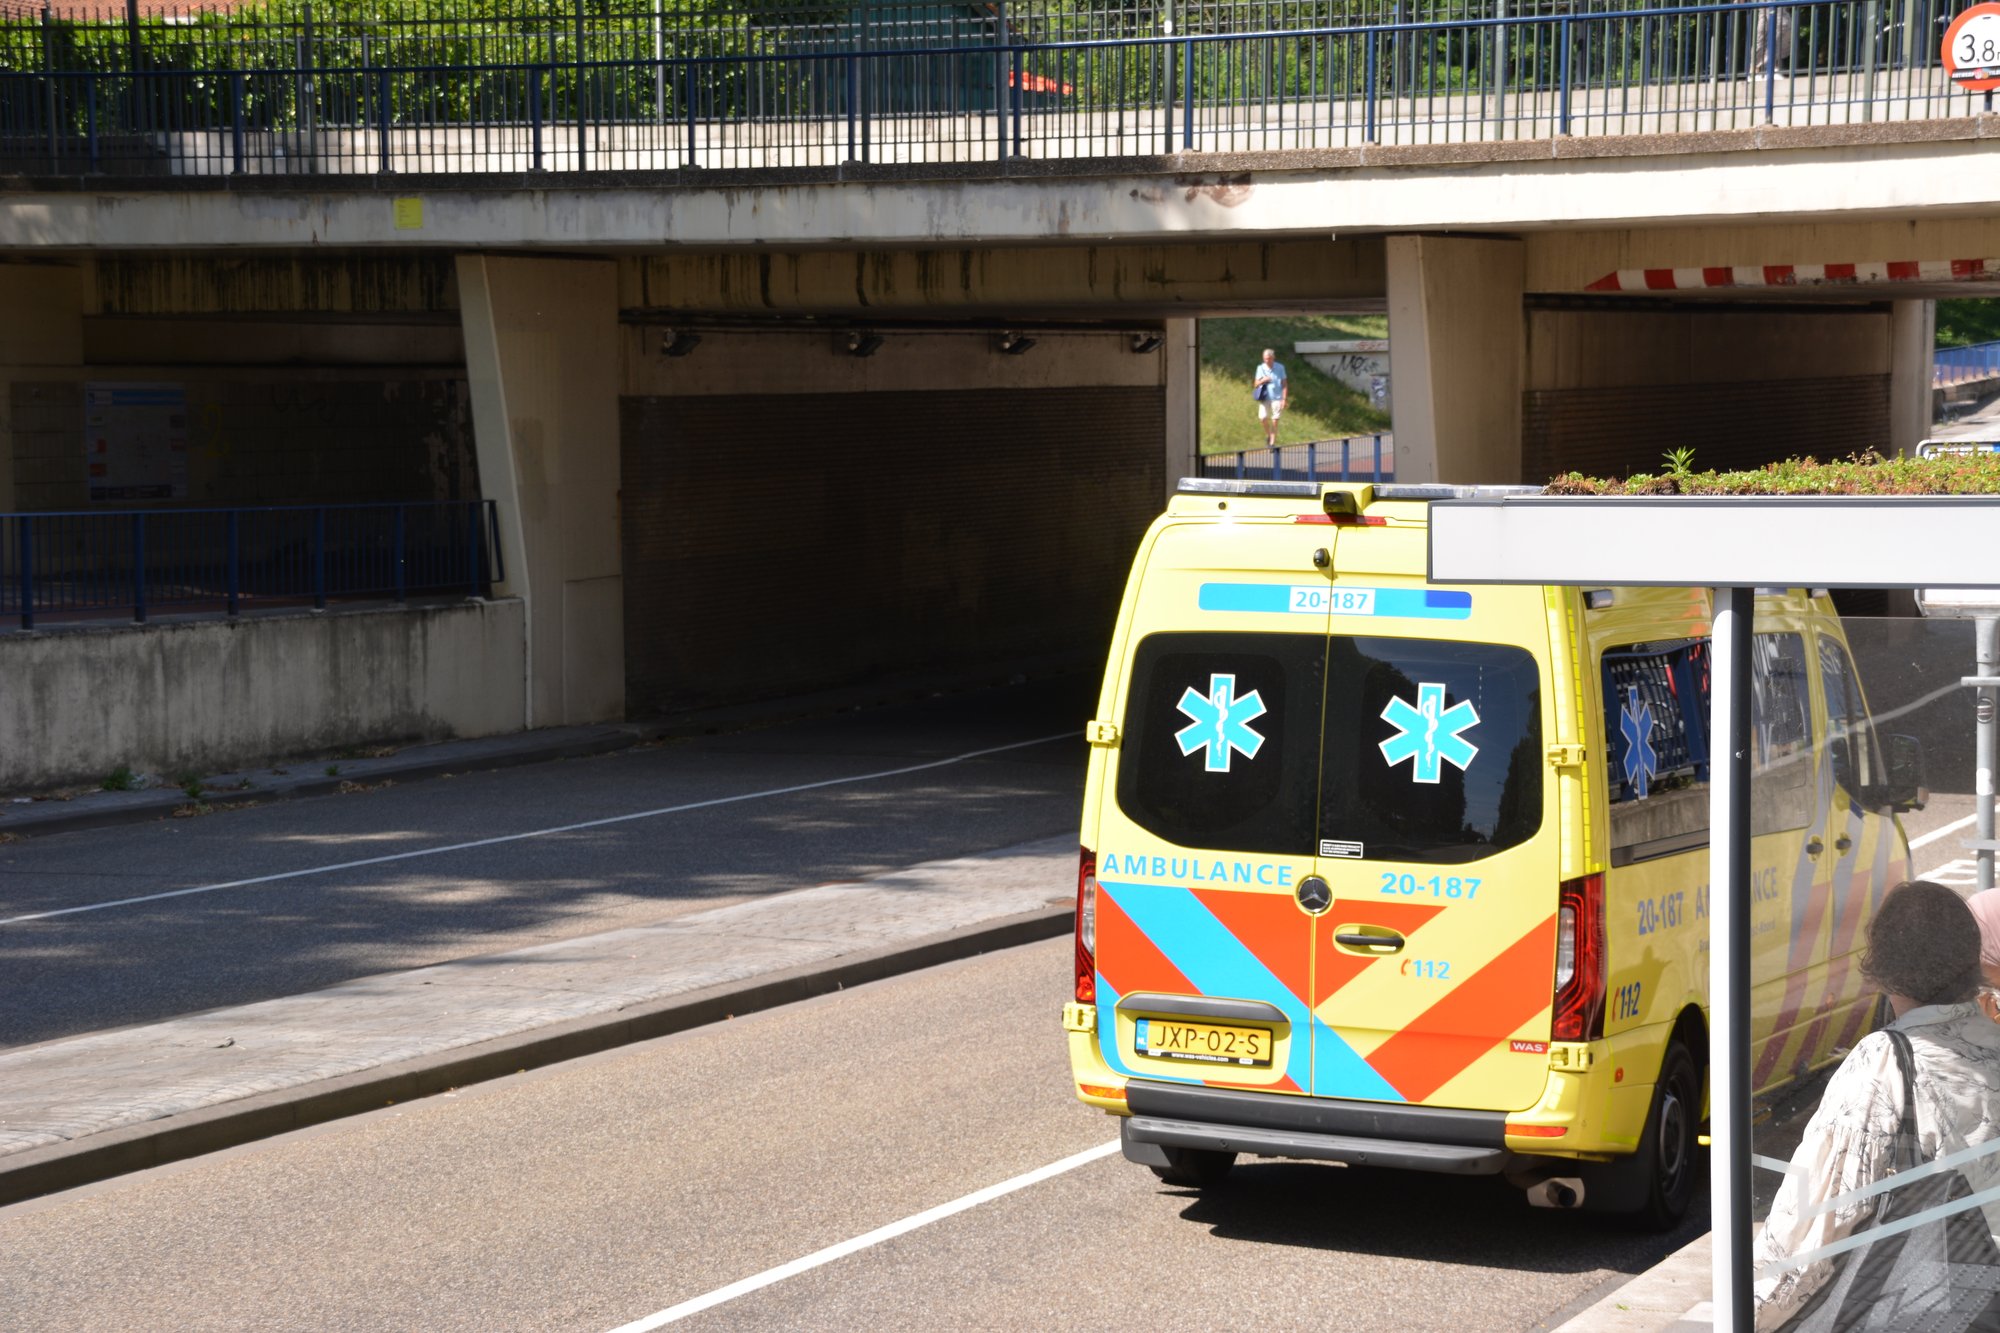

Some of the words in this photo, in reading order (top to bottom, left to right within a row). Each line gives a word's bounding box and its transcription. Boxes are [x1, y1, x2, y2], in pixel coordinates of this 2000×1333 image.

[1959, 34, 2000, 63] 3,8
[1295, 591, 1368, 609] 20-187
[1102, 853, 1292, 886] AMBULANCE
[1380, 872, 1482, 899] 20-187
[1637, 891, 1684, 936] 20-187
[1156, 1026, 1259, 1055] JXP-02-S
[1512, 1041, 1543, 1052] WAS
